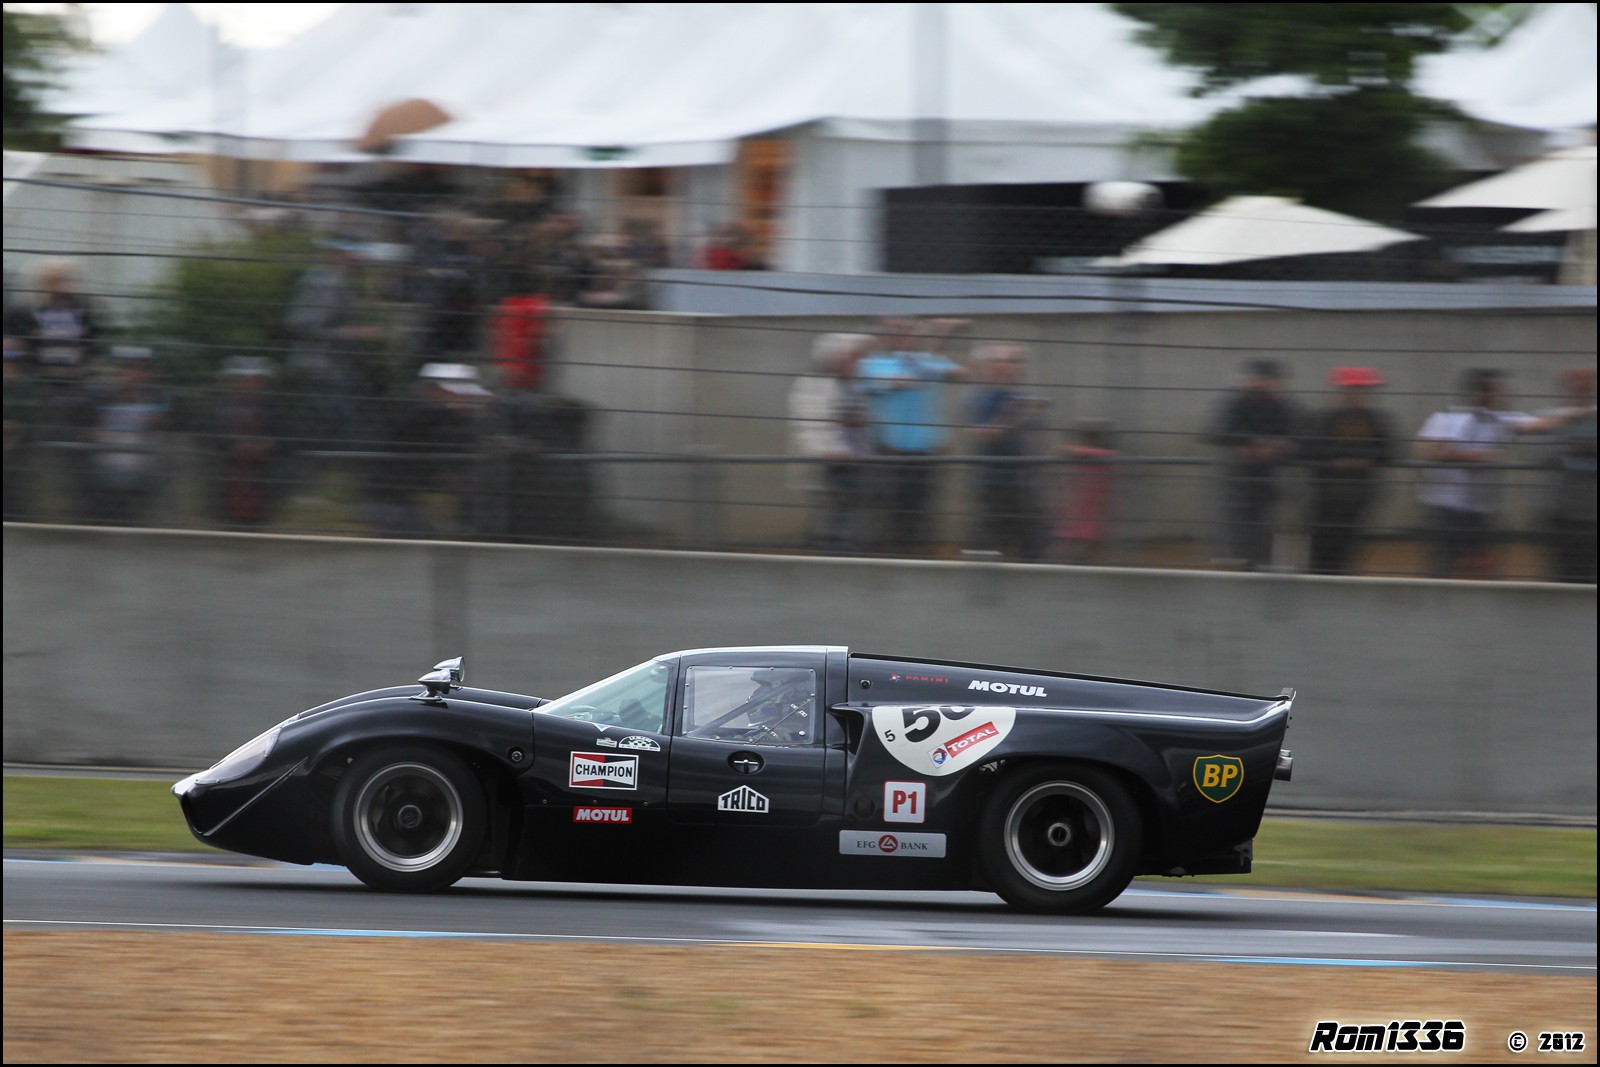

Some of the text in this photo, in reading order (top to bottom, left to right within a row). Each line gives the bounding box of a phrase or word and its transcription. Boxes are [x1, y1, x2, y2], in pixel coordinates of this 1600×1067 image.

[905, 675, 949, 683] PANINI
[967, 680, 1048, 697] MOTUL
[884, 730, 896, 742] 5
[947, 728, 996, 752] TOTAL
[575, 764, 633, 777] CHAMPION
[1202, 764, 1238, 787] BP
[721, 787, 766, 811] TRICO
[892, 790, 917, 814] P1
[576, 808, 629, 821] MOTUL
[856, 840, 928, 850] EFG BANK
